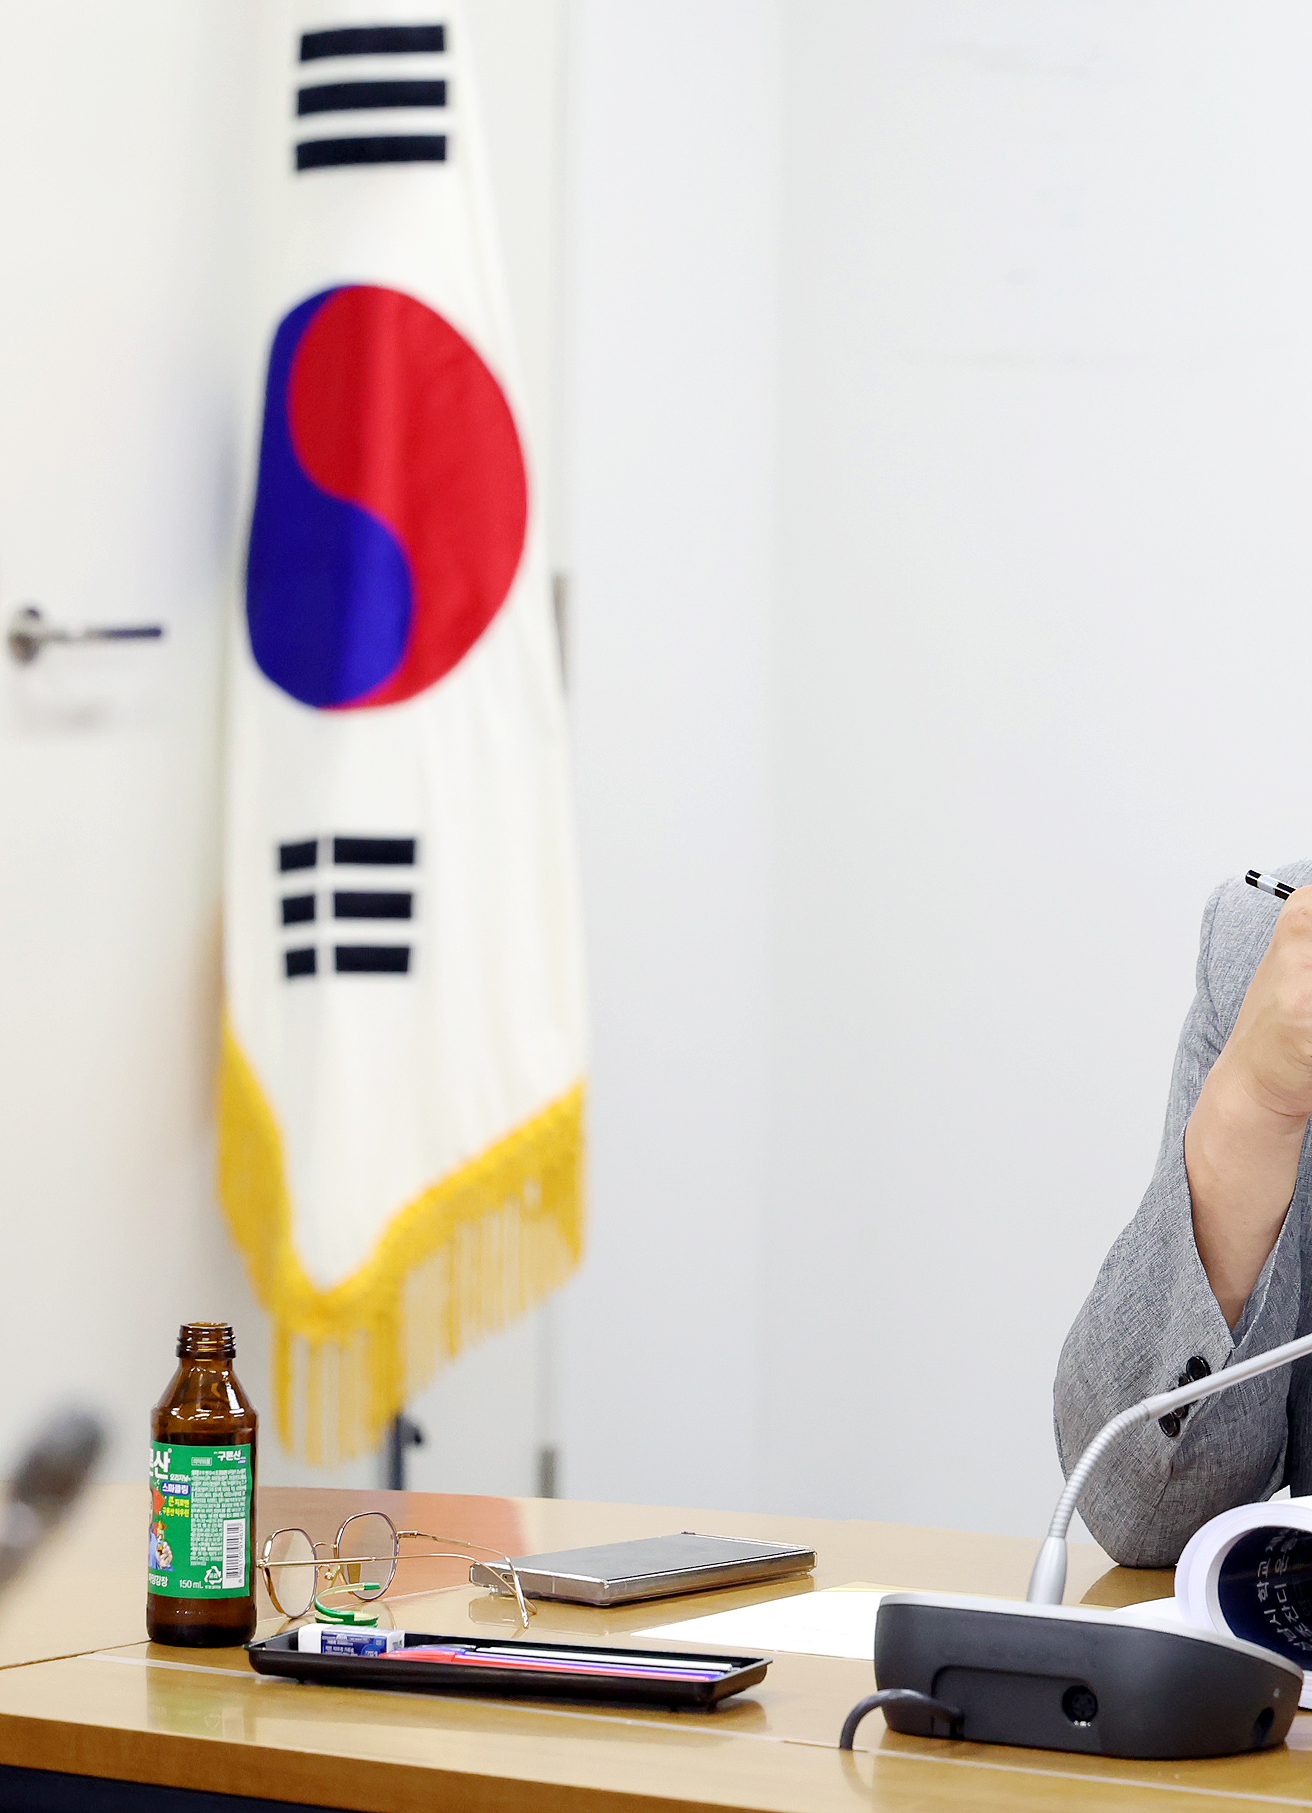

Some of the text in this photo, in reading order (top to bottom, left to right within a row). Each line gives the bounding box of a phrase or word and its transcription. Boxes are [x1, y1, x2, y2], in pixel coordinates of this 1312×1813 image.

[149, 1447, 171, 1480] 산
[162, 1482, 189, 1495] 스파클링
[1255, 1557, 1272, 1603] 학교
